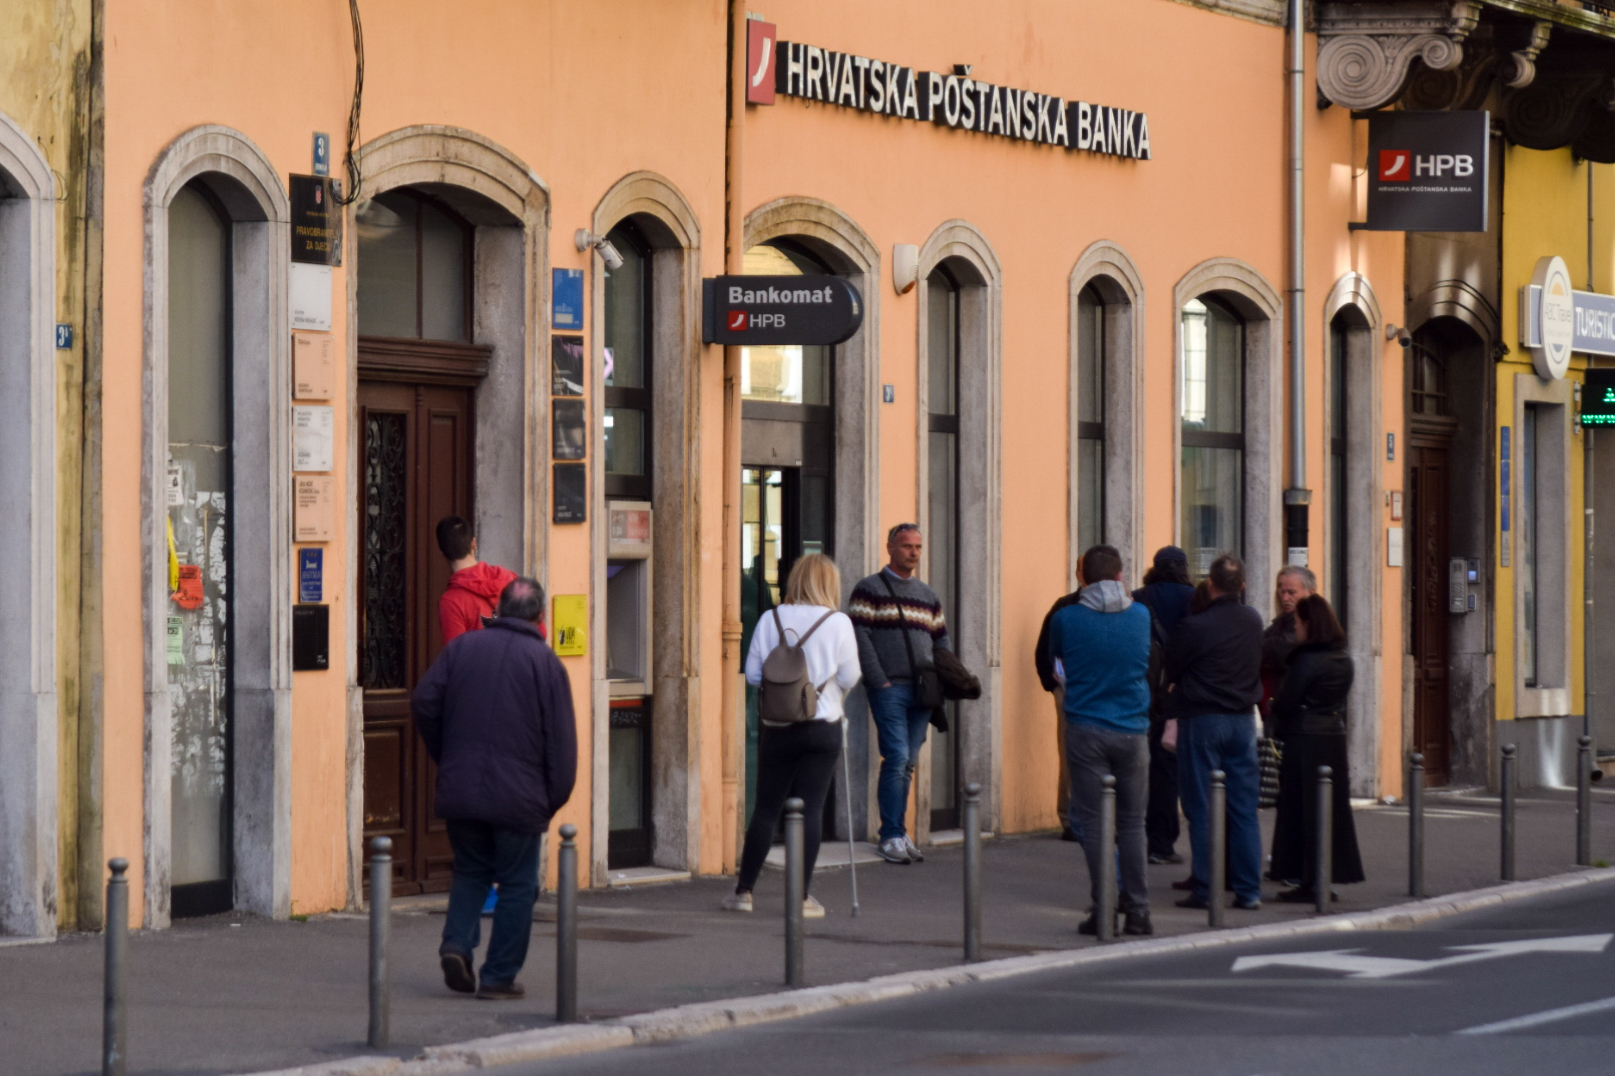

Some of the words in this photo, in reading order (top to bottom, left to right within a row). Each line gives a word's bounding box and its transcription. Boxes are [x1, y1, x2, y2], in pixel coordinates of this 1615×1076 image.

[788, 41, 919, 119] HRVATSKA
[928, 64, 1069, 147] POŠTANSKA
[1077, 101, 1152, 160] BANKA
[317, 137, 325, 156] 3
[1415, 154, 1474, 177] HPB
[1411, 185, 1449, 193] POŠTANSKA
[729, 285, 833, 304] Bankomat
[750, 313, 786, 328] HPB
